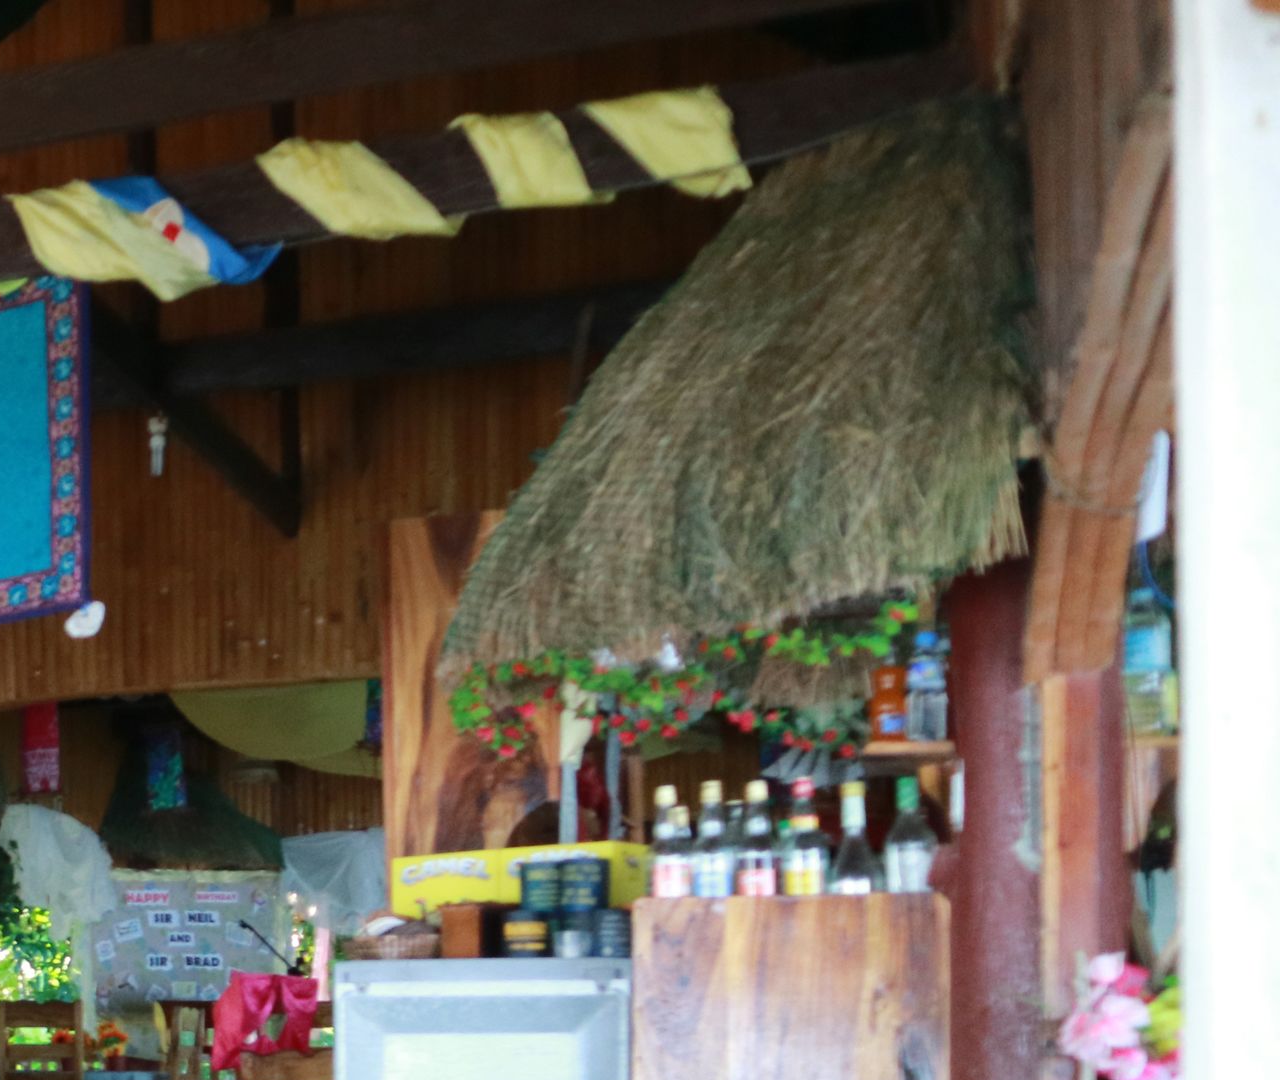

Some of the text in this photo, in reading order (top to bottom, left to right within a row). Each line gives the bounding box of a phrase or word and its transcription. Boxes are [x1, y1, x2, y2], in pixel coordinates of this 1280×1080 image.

[401, 858, 489, 885] CAMEL
[125, 892, 169, 904] HAPPY
[154, 913, 216, 923] SIR NEIL
[169, 934, 191, 943] AND
[149, 956, 220, 967] SIR BRAD
